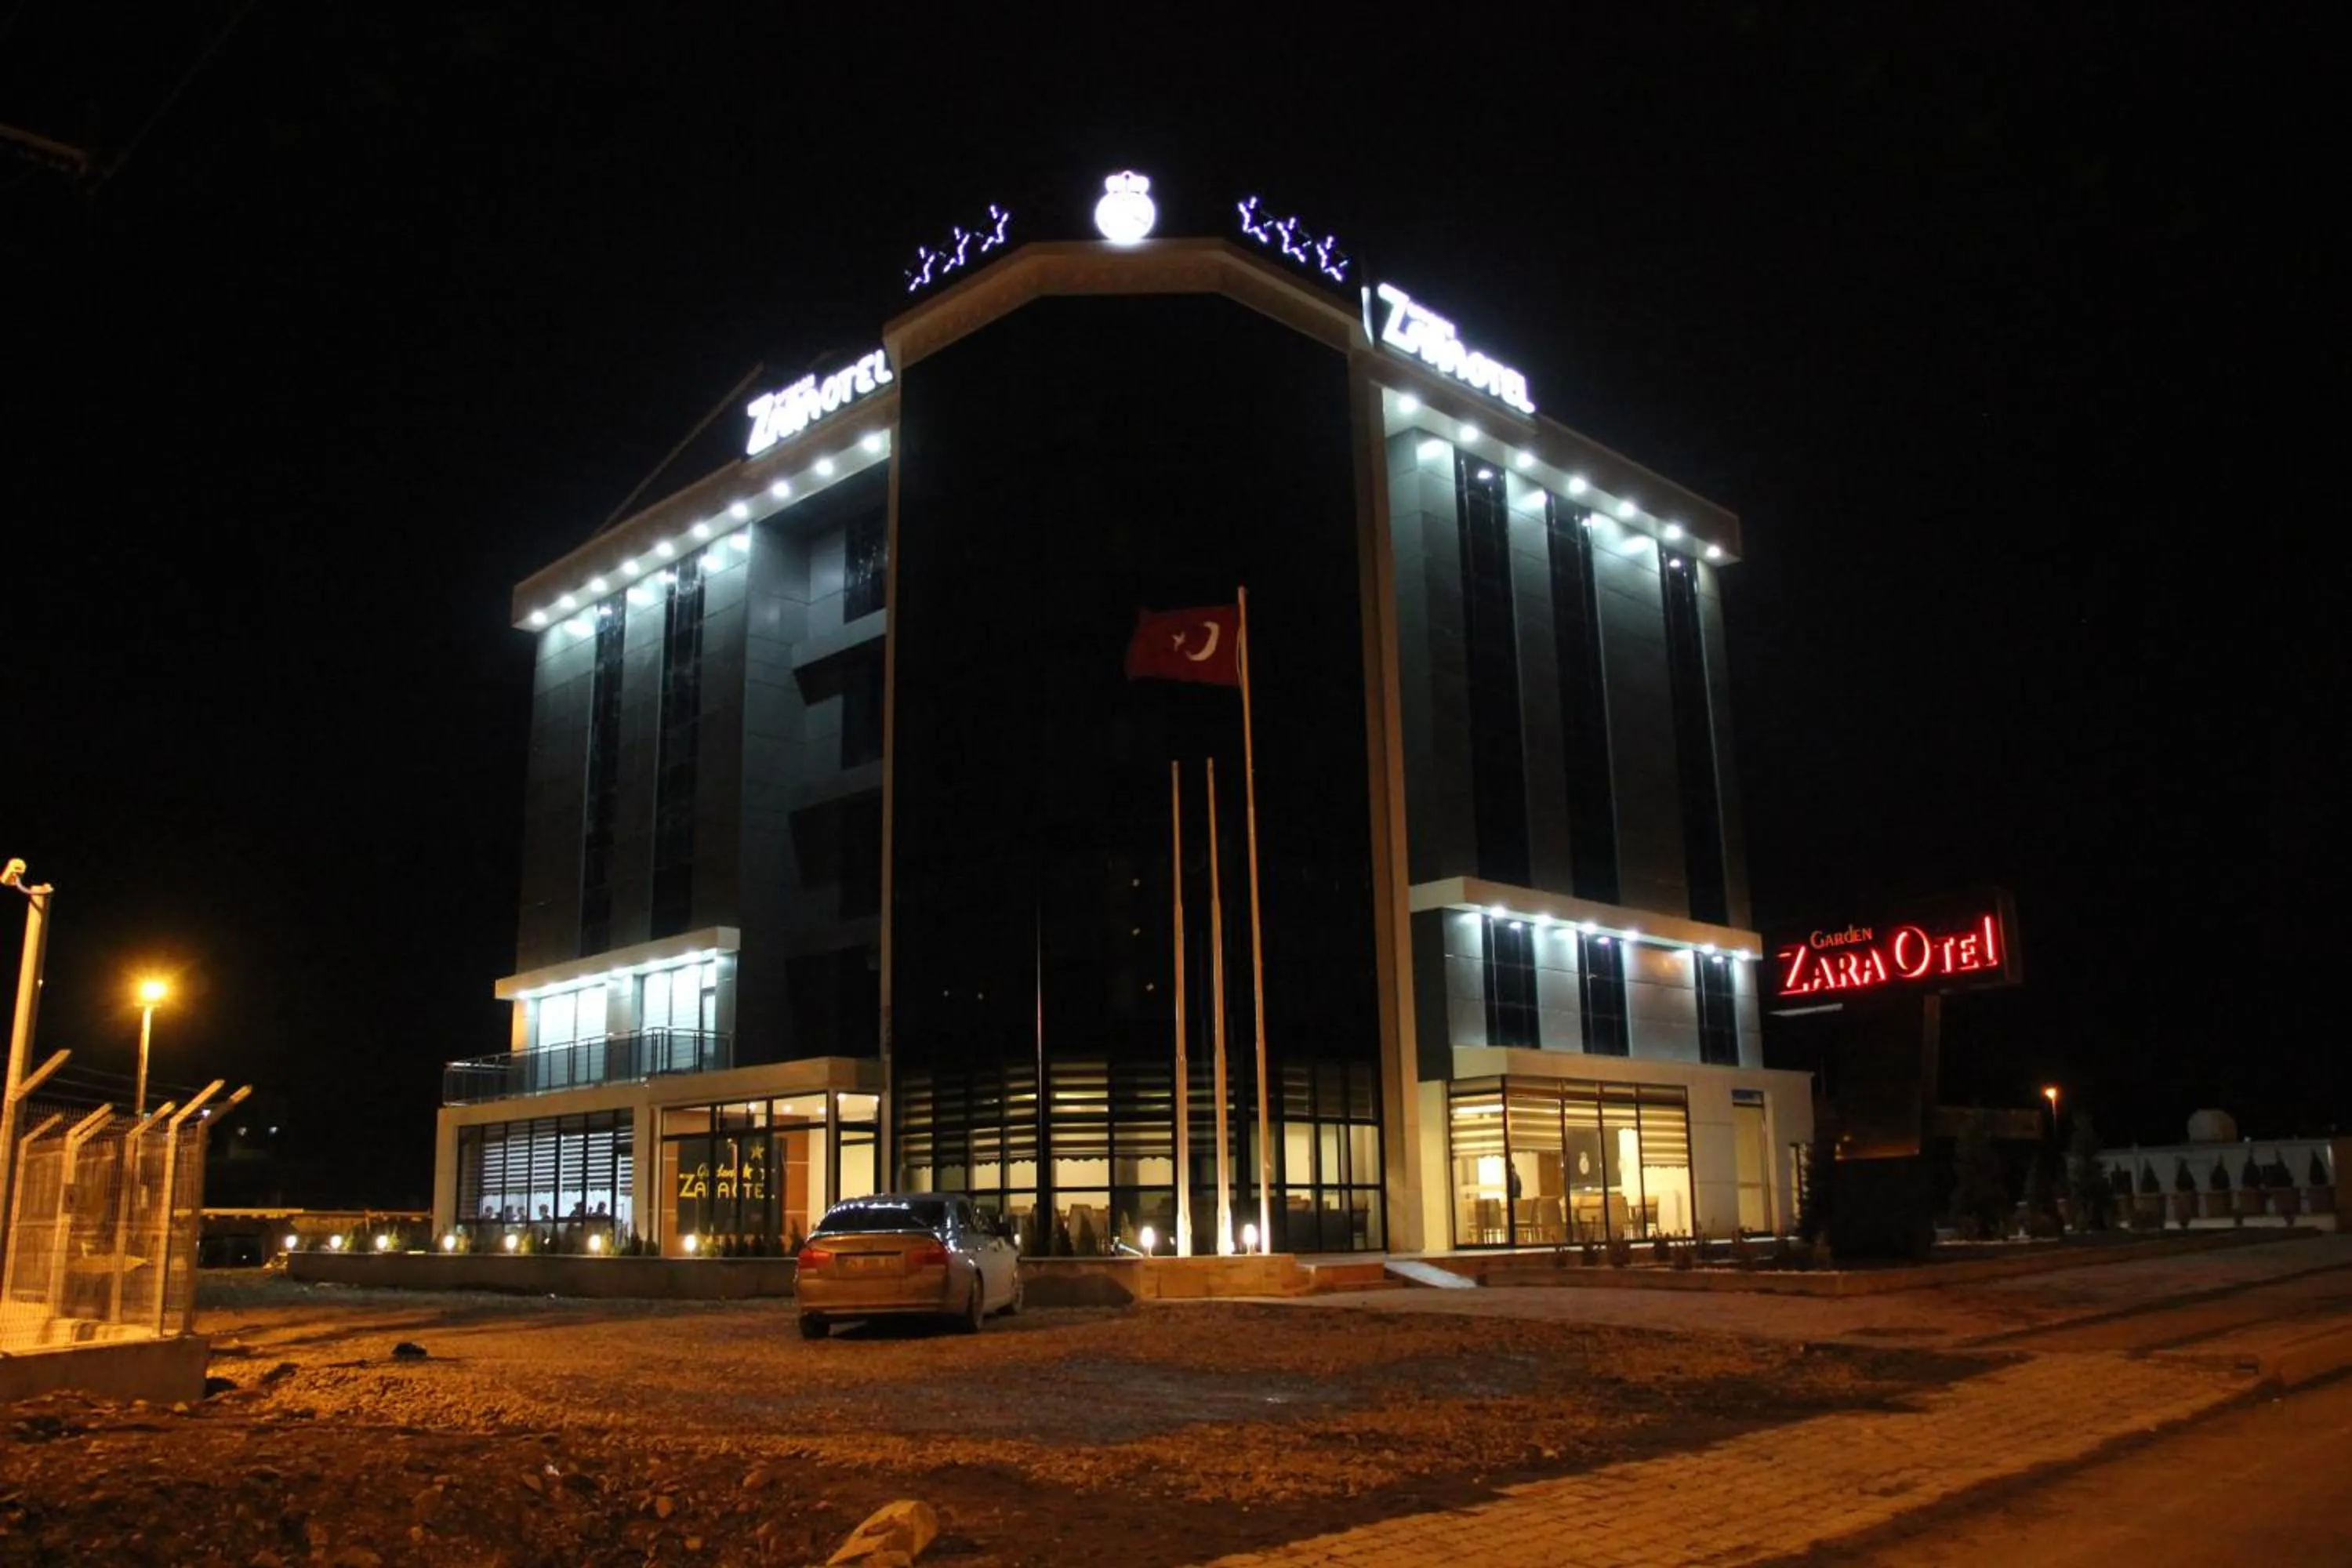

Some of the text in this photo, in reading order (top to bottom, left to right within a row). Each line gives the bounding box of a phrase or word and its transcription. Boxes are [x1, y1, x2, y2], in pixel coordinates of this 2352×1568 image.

[821, 349, 893, 412] OTEL
[1777, 945, 1888, 996] ZARA
[679, 1173, 776, 1200] ZAA TE
